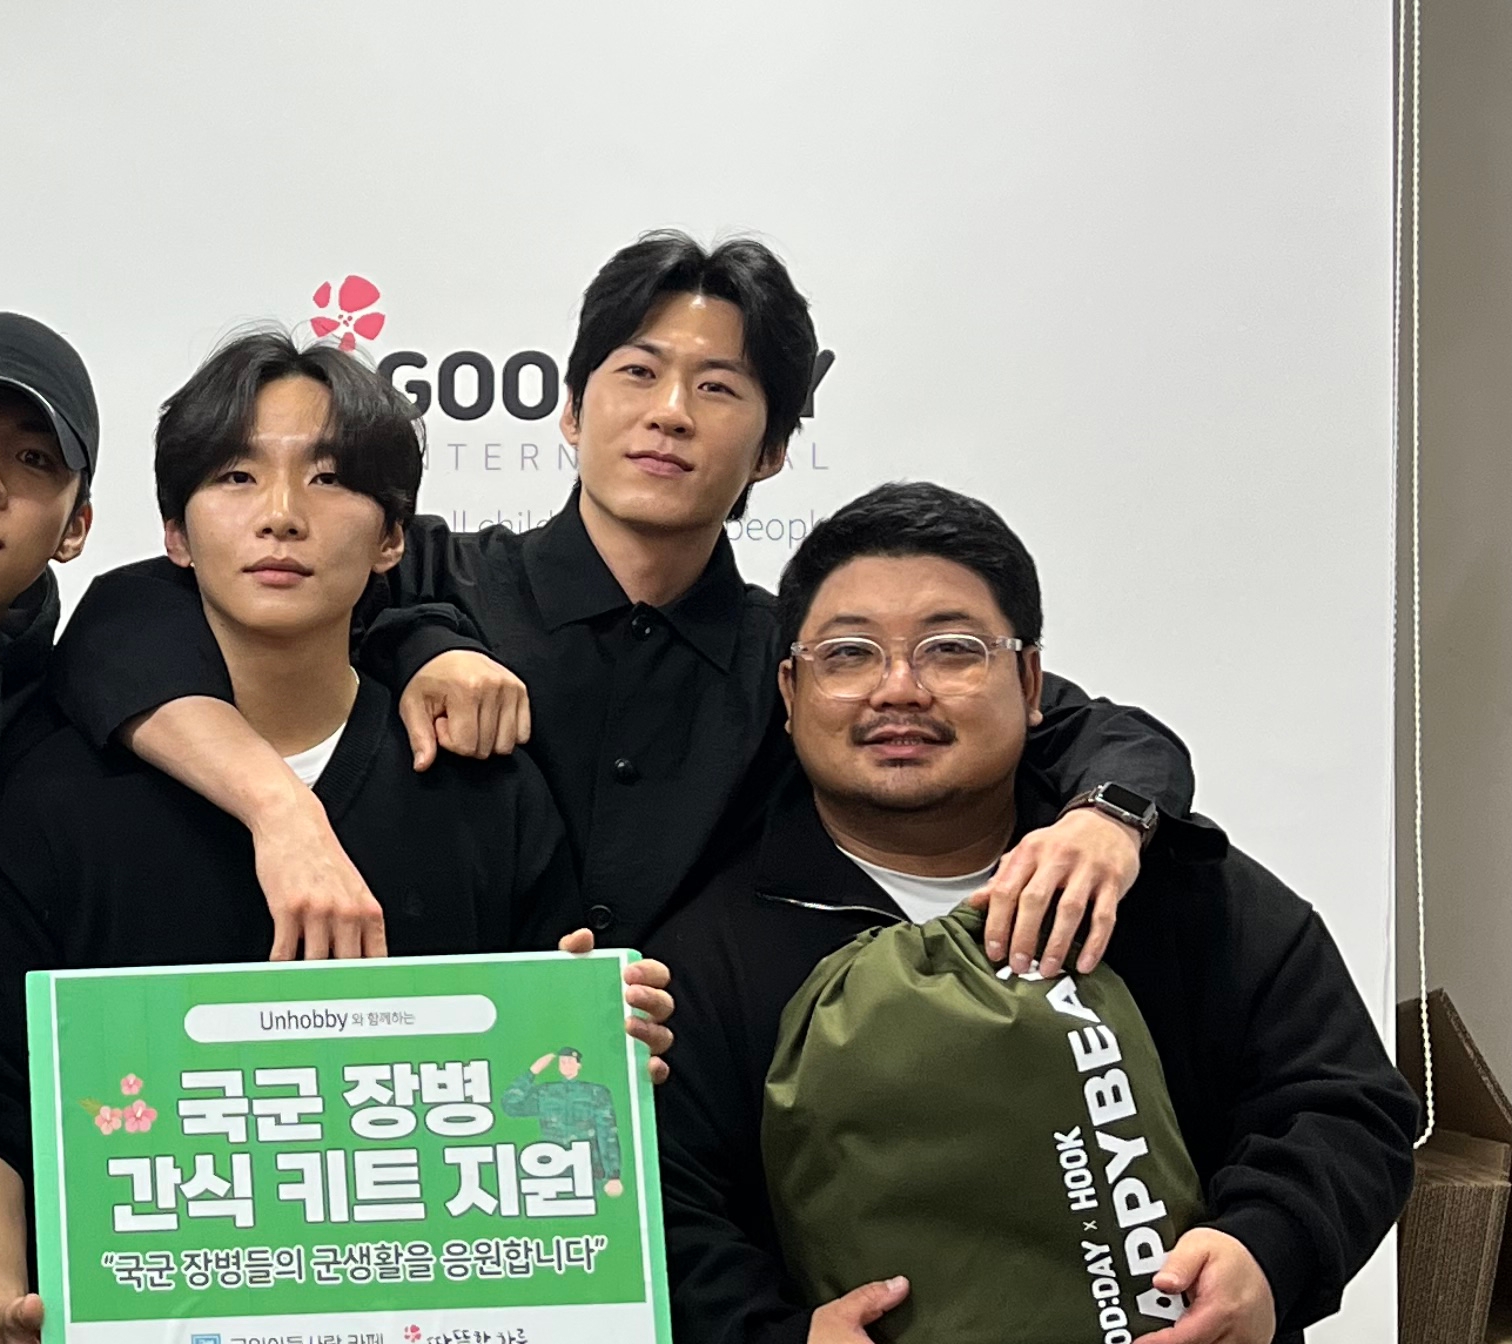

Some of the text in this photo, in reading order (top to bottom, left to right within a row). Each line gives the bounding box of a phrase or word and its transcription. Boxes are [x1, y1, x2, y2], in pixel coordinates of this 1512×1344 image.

[376, 350, 559, 421] GOO
[259, 1009, 416, 1033] Unhobby 와 함께하는
[177, 1059, 496, 1144] 국군 장병
[106, 1139, 597, 1233] 간식 키트 지원
[1053, 1125, 1099, 1212] HOOK
[182, 1249, 303, 1287] 장병들의
[312, 1245, 434, 1283] 군생활을
